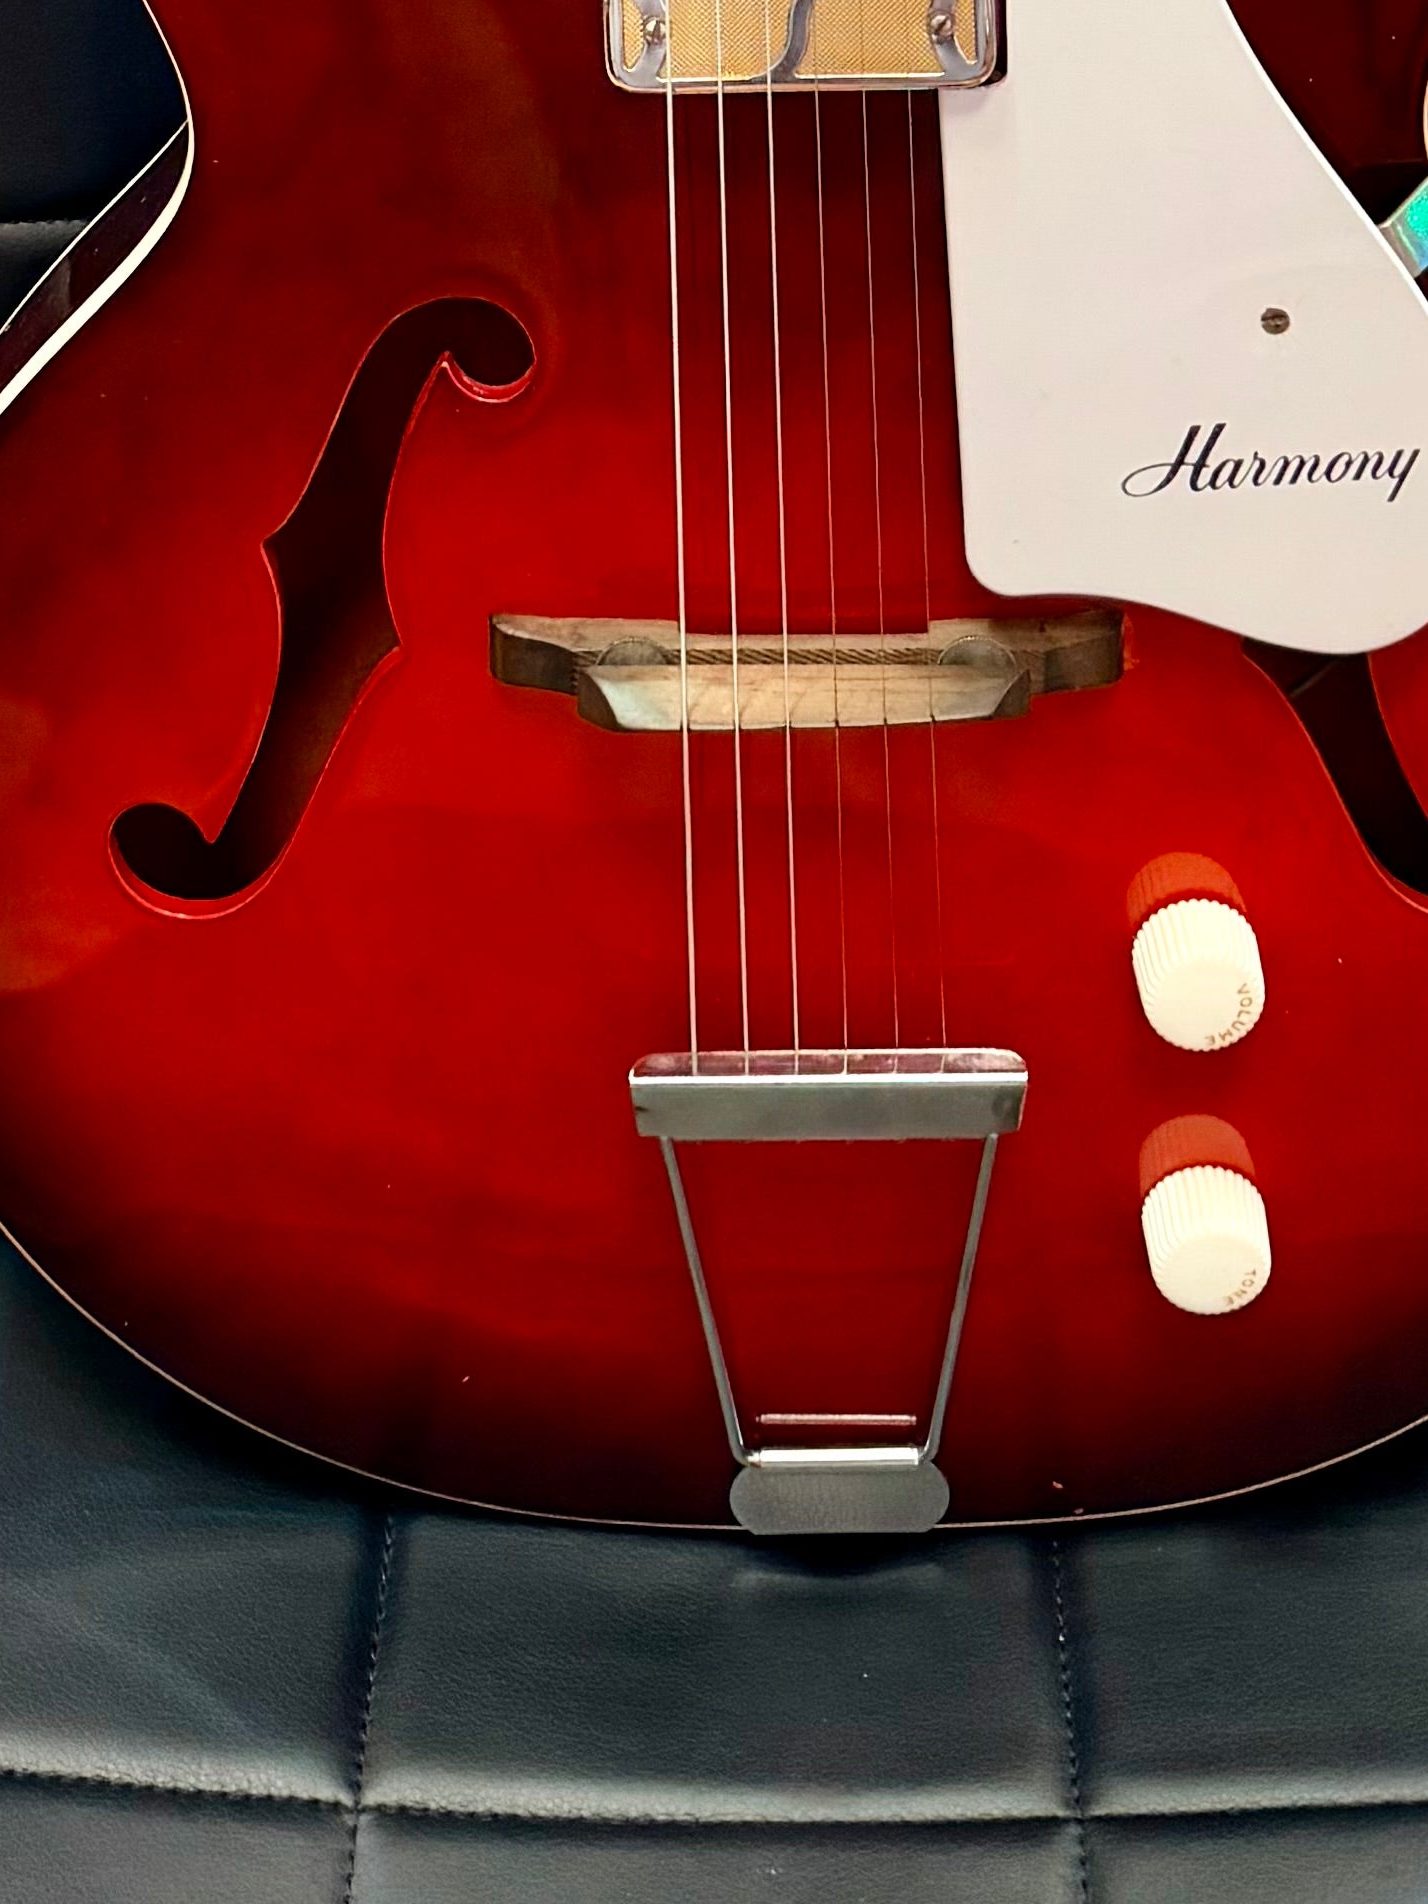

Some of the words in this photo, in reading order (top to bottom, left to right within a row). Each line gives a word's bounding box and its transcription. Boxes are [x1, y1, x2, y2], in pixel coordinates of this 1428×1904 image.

[1120, 422, 1422, 503] Harmony
[1204, 983, 1253, 1047] VOLUME
[1225, 1269, 1257, 1307] TONE
